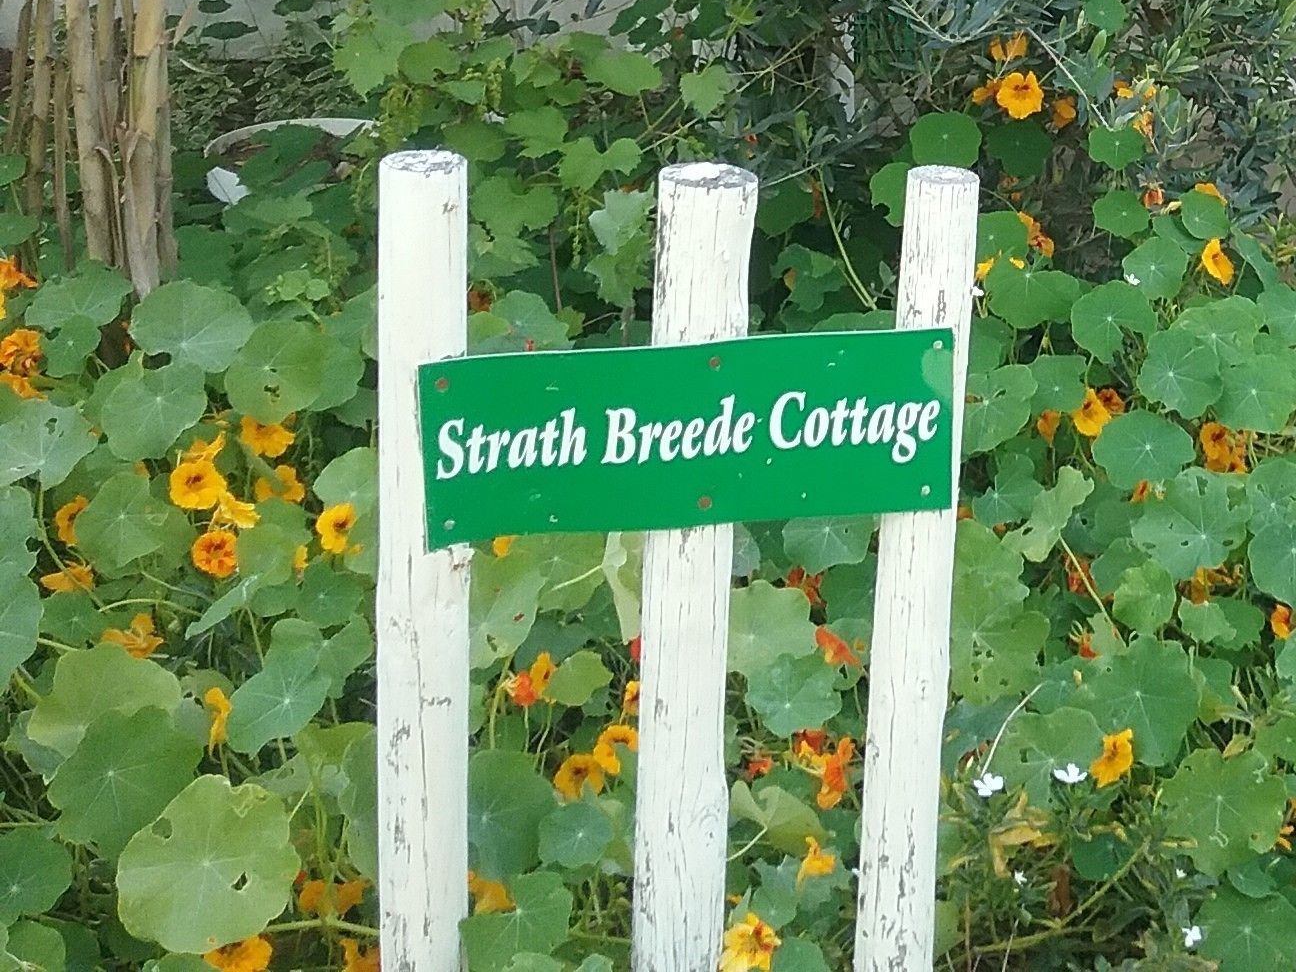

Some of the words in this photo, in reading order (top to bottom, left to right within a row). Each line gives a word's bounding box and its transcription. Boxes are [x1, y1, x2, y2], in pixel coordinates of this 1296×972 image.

[435, 407, 587, 480] Strath
[601, 394, 756, 464] Breede
[769, 391, 941, 463] Cottage
